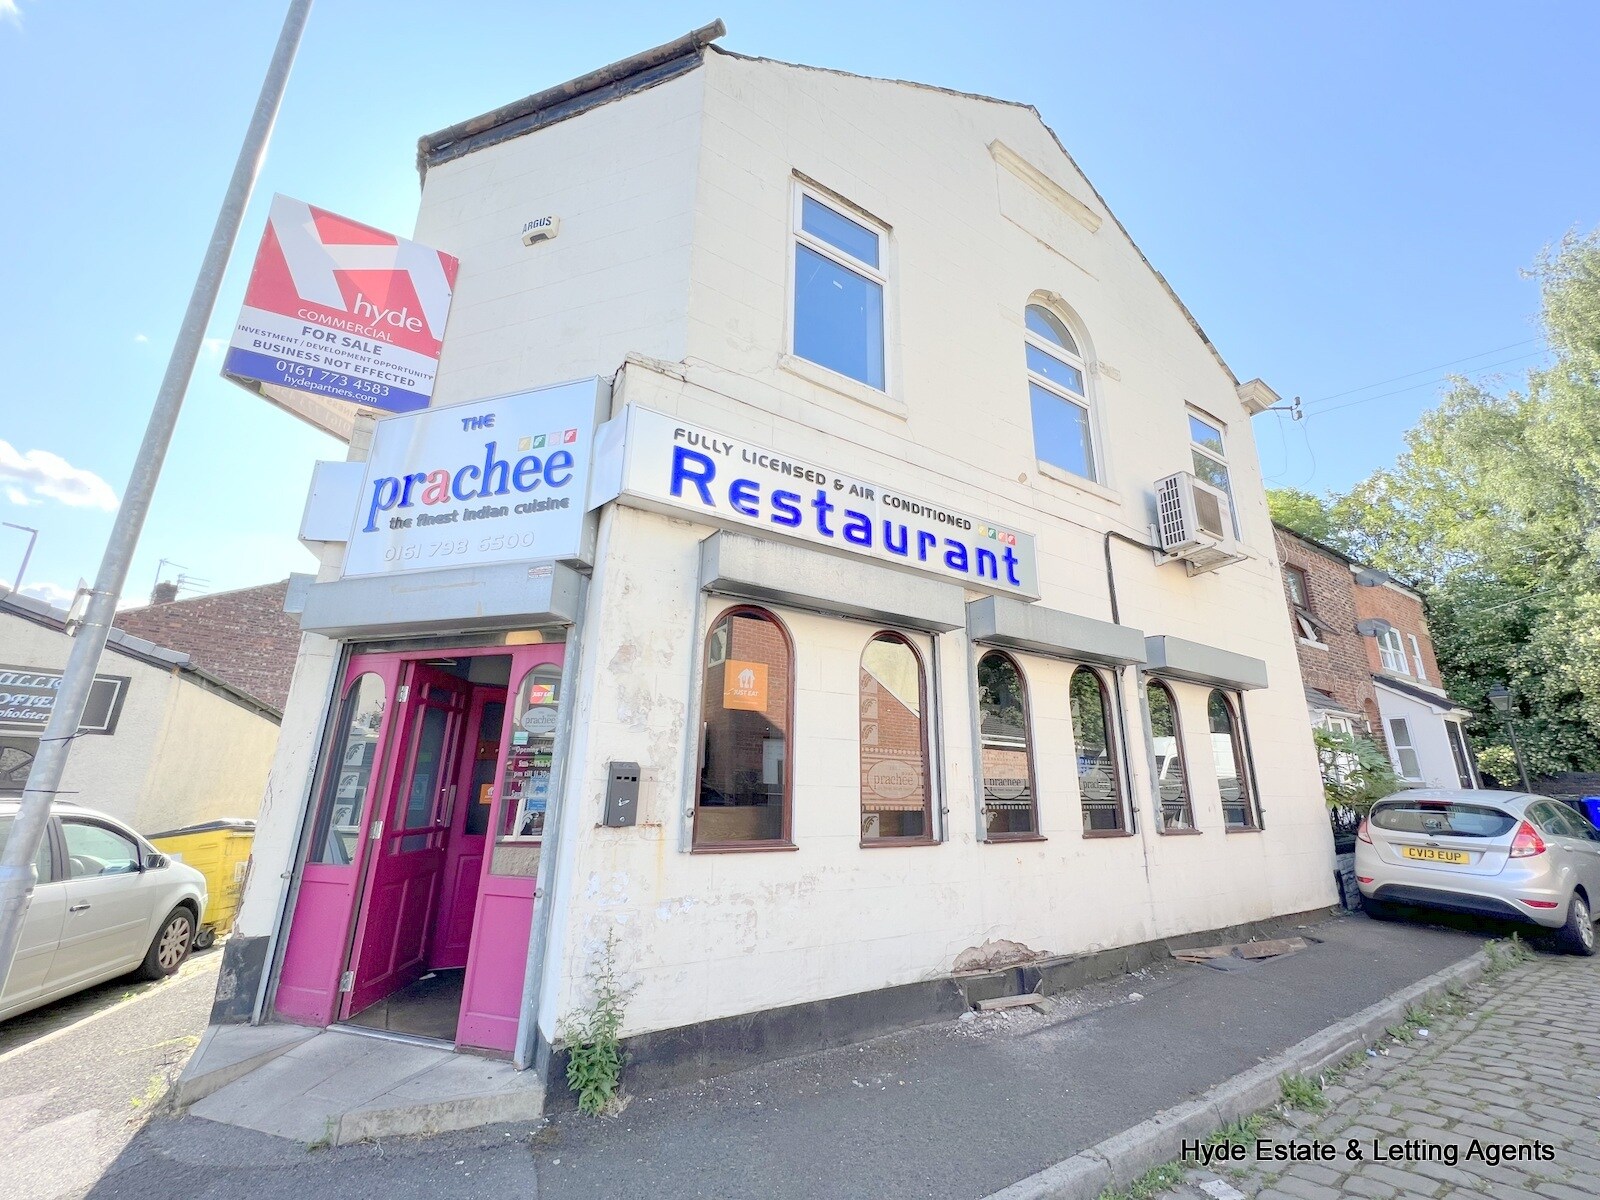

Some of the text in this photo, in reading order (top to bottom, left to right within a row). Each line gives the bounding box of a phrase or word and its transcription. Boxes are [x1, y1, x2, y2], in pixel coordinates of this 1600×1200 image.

[522, 216, 552, 234] ARGUS
[297, 308, 394, 343] COMMERCIAL
[353, 293, 423, 333] hyde
[237, 324, 298, 346] INVESTMENT
[306, 341, 372, 364] DEVELOPMENT
[373, 359, 434, 381] OPPORTUNITY
[301, 326, 383, 356] FOR SALE
[253, 339, 416, 387] BUSINESS NOT EFFECTED
[276, 360, 390, 397] 0161 773 4583
[284, 374, 378, 404] hydepartners.com
[461, 413, 496, 432] THE
[363, 441, 575, 533] prachee
[674, 427, 972, 531] FULLY LICENSED & AIR CONDITIONED
[389, 497, 570, 530] the finest indian cuisine
[669, 444, 1021, 587] Restaurant
[384, 542, 421, 562] 0161
[0, 708, 51, 722] pholster
[525, 715, 556, 727] prachee
[515, 746, 539, 754] Opening
[873, 772, 914, 790] prachee
[1409, 847, 1462, 861] CV13 EUP
